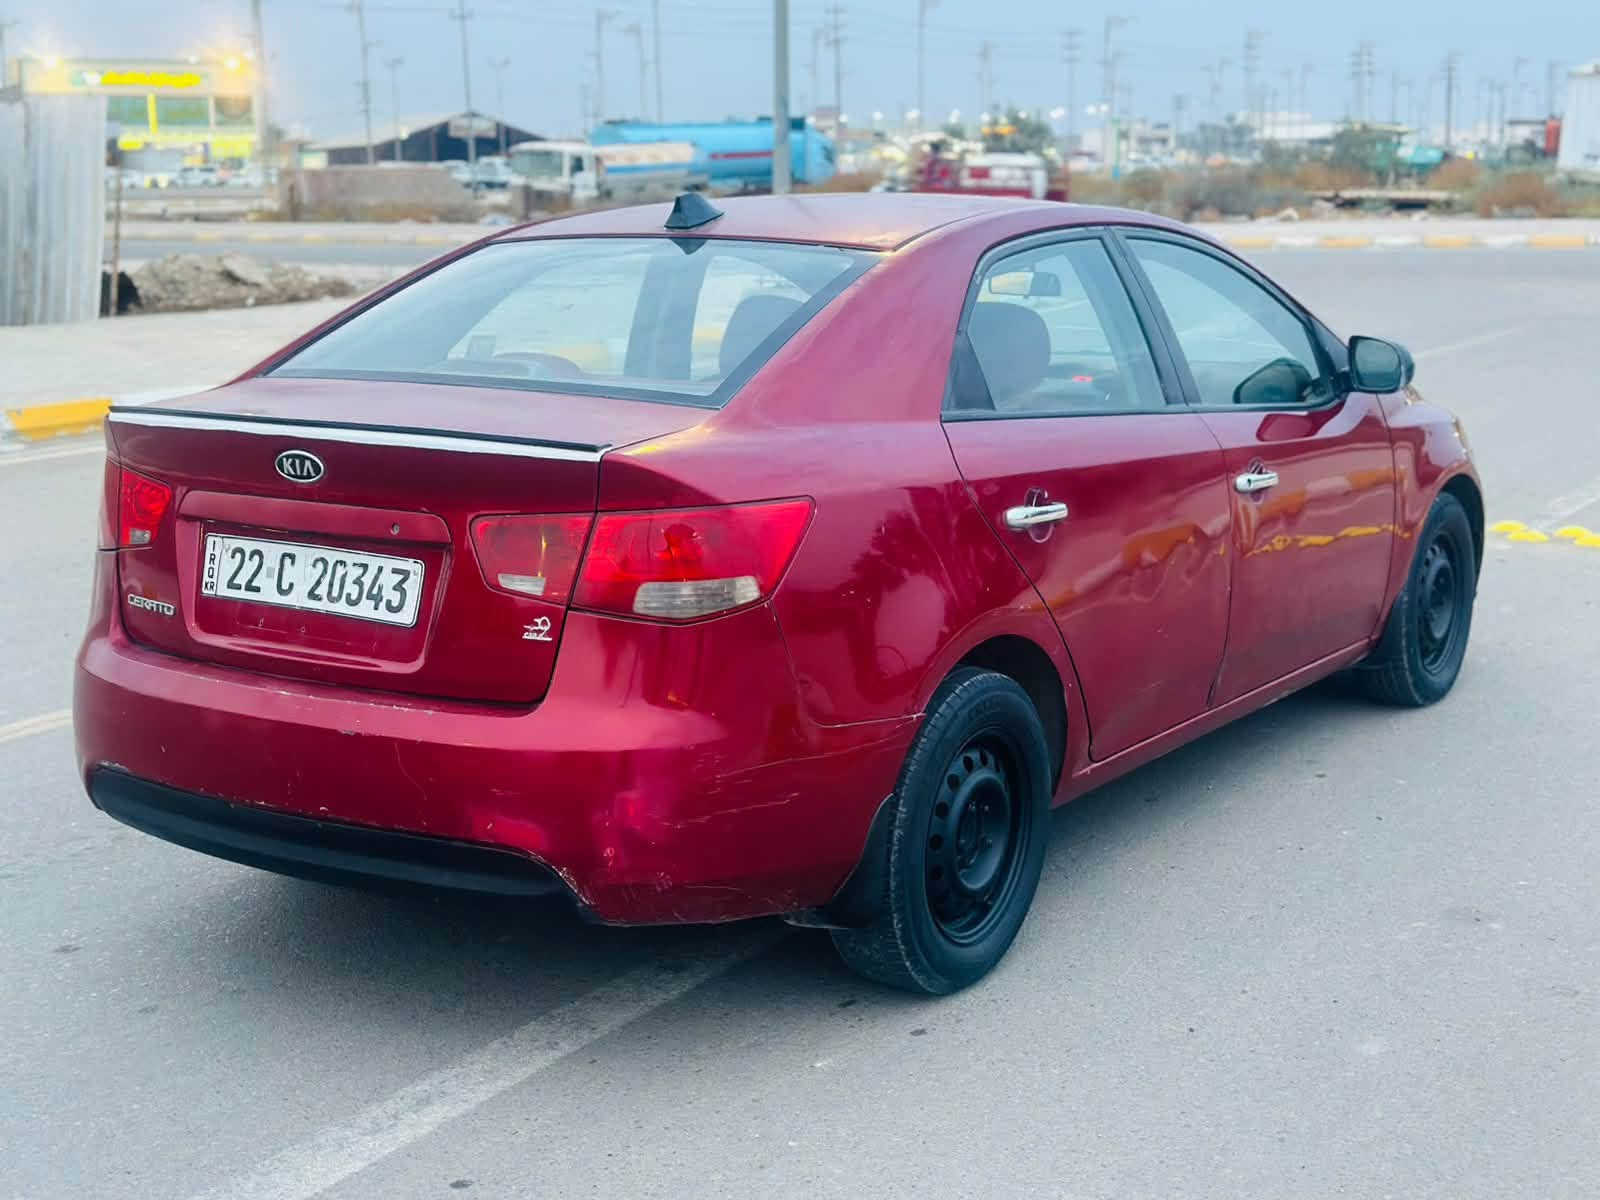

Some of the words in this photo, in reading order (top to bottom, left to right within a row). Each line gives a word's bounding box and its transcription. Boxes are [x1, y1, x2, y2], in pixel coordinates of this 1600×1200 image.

[283, 457, 316, 477] KIA
[226, 546, 265, 593] 22
[276, 551, 296, 597] C
[306, 556, 412, 615] 20343
